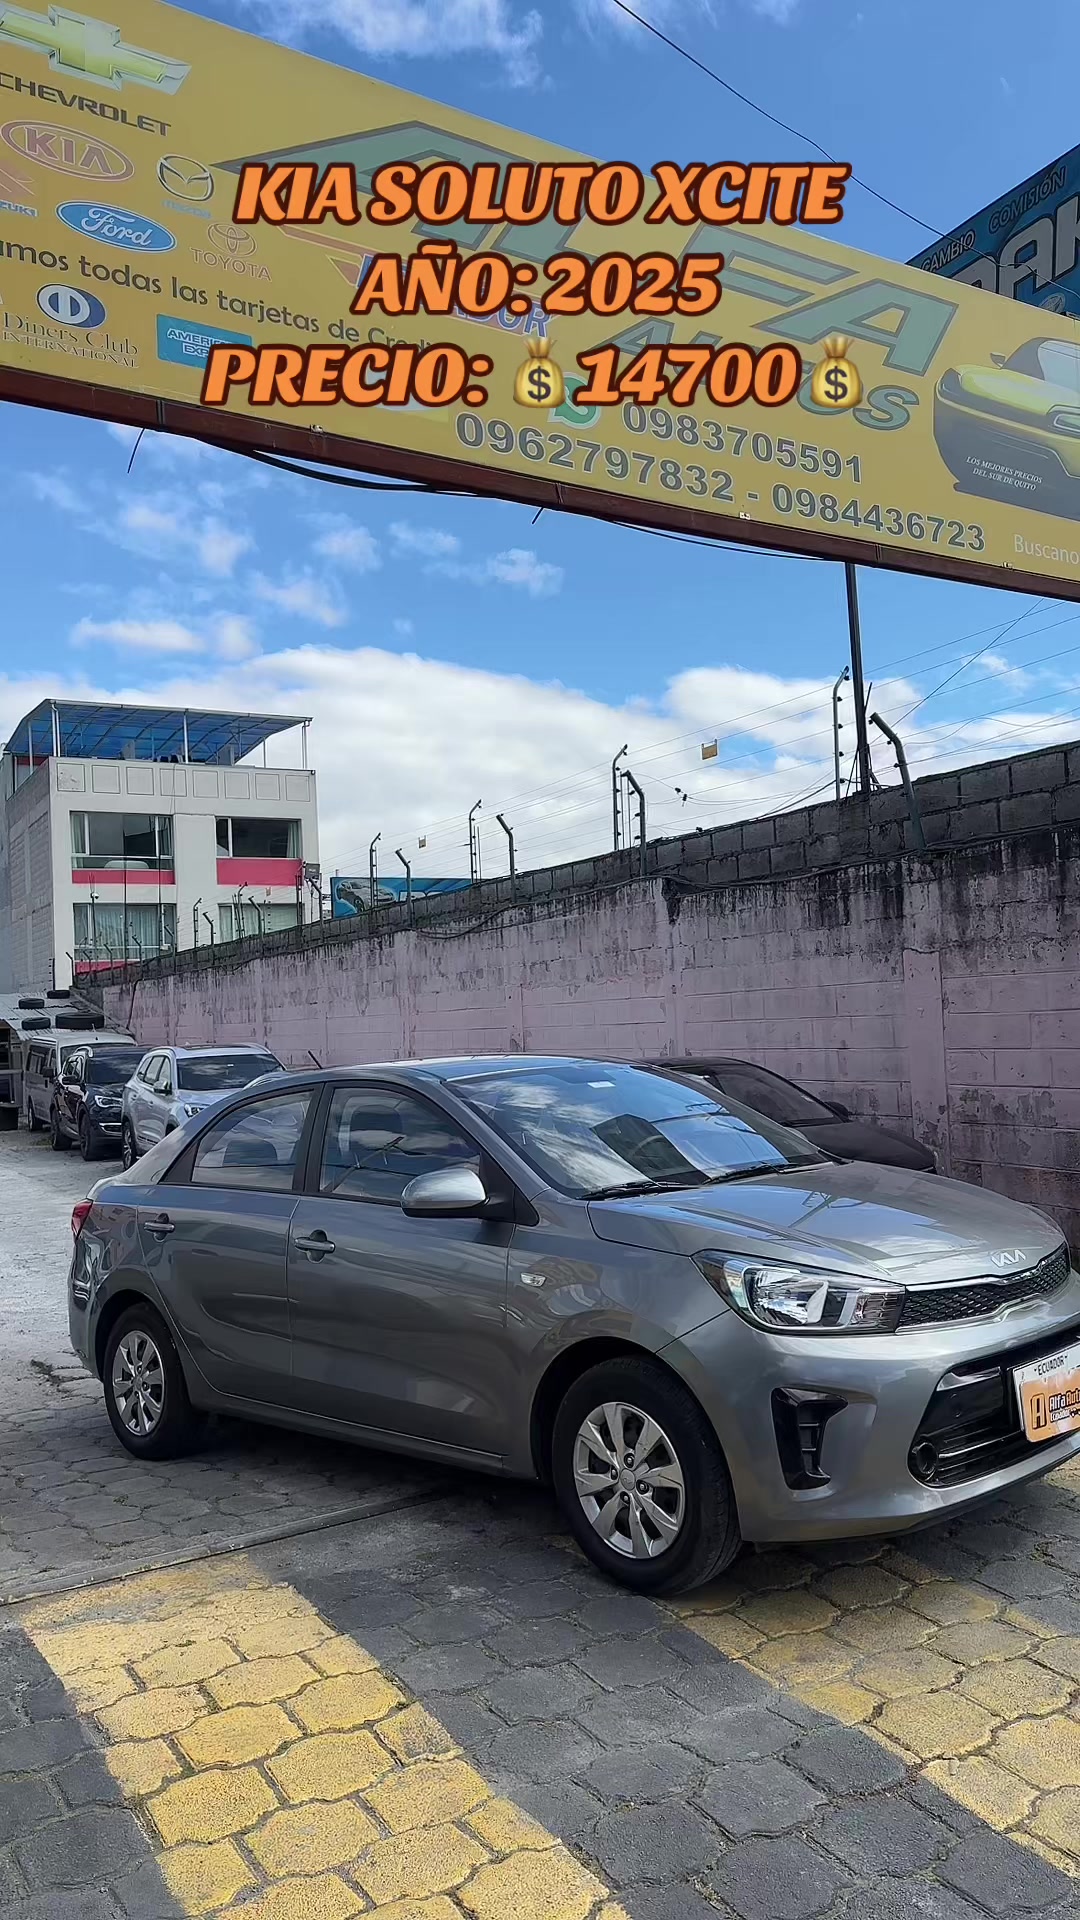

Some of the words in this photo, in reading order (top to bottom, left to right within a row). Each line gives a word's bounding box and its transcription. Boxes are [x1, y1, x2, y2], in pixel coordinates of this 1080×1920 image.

[0, 72, 172, 137] CHEVROLET
[23, 126, 114, 175] KIA
[989, 165, 1067, 234] COMISIÓN
[81, 207, 152, 246] Ford
[190, 247, 273, 283] TOYOTA
[920, 229, 976, 275] CAMBIO
[0, 239, 69, 271] mos
[79, 255, 162, 294] todas
[172, 276, 208, 306] las
[216, 289, 320, 333] tarjetas
[327, 318, 360, 342] de
[3, 331, 139, 369] INTERNATIONAL
[4, 312, 78, 343] Diners
[86, 331, 138, 356] Club
[622, 400, 861, 484] 0983705591
[456, 412, 735, 503] 0962797832
[771, 483, 985, 552] 0984436723
[966, 456, 981, 467] LOS
[981, 460, 1013, 475] MEJORES
[1014, 469, 1042, 483] PRECIOS
[973, 467, 988, 478] DEL
[988, 472, 1002, 482] SUR
[1003, 477, 1013, 485] DE
[1014, 479, 1036, 491] QUITO
[1014, 533, 1080, 565] Buscano
[1038, 1356, 1065, 1376] ECUADOR
